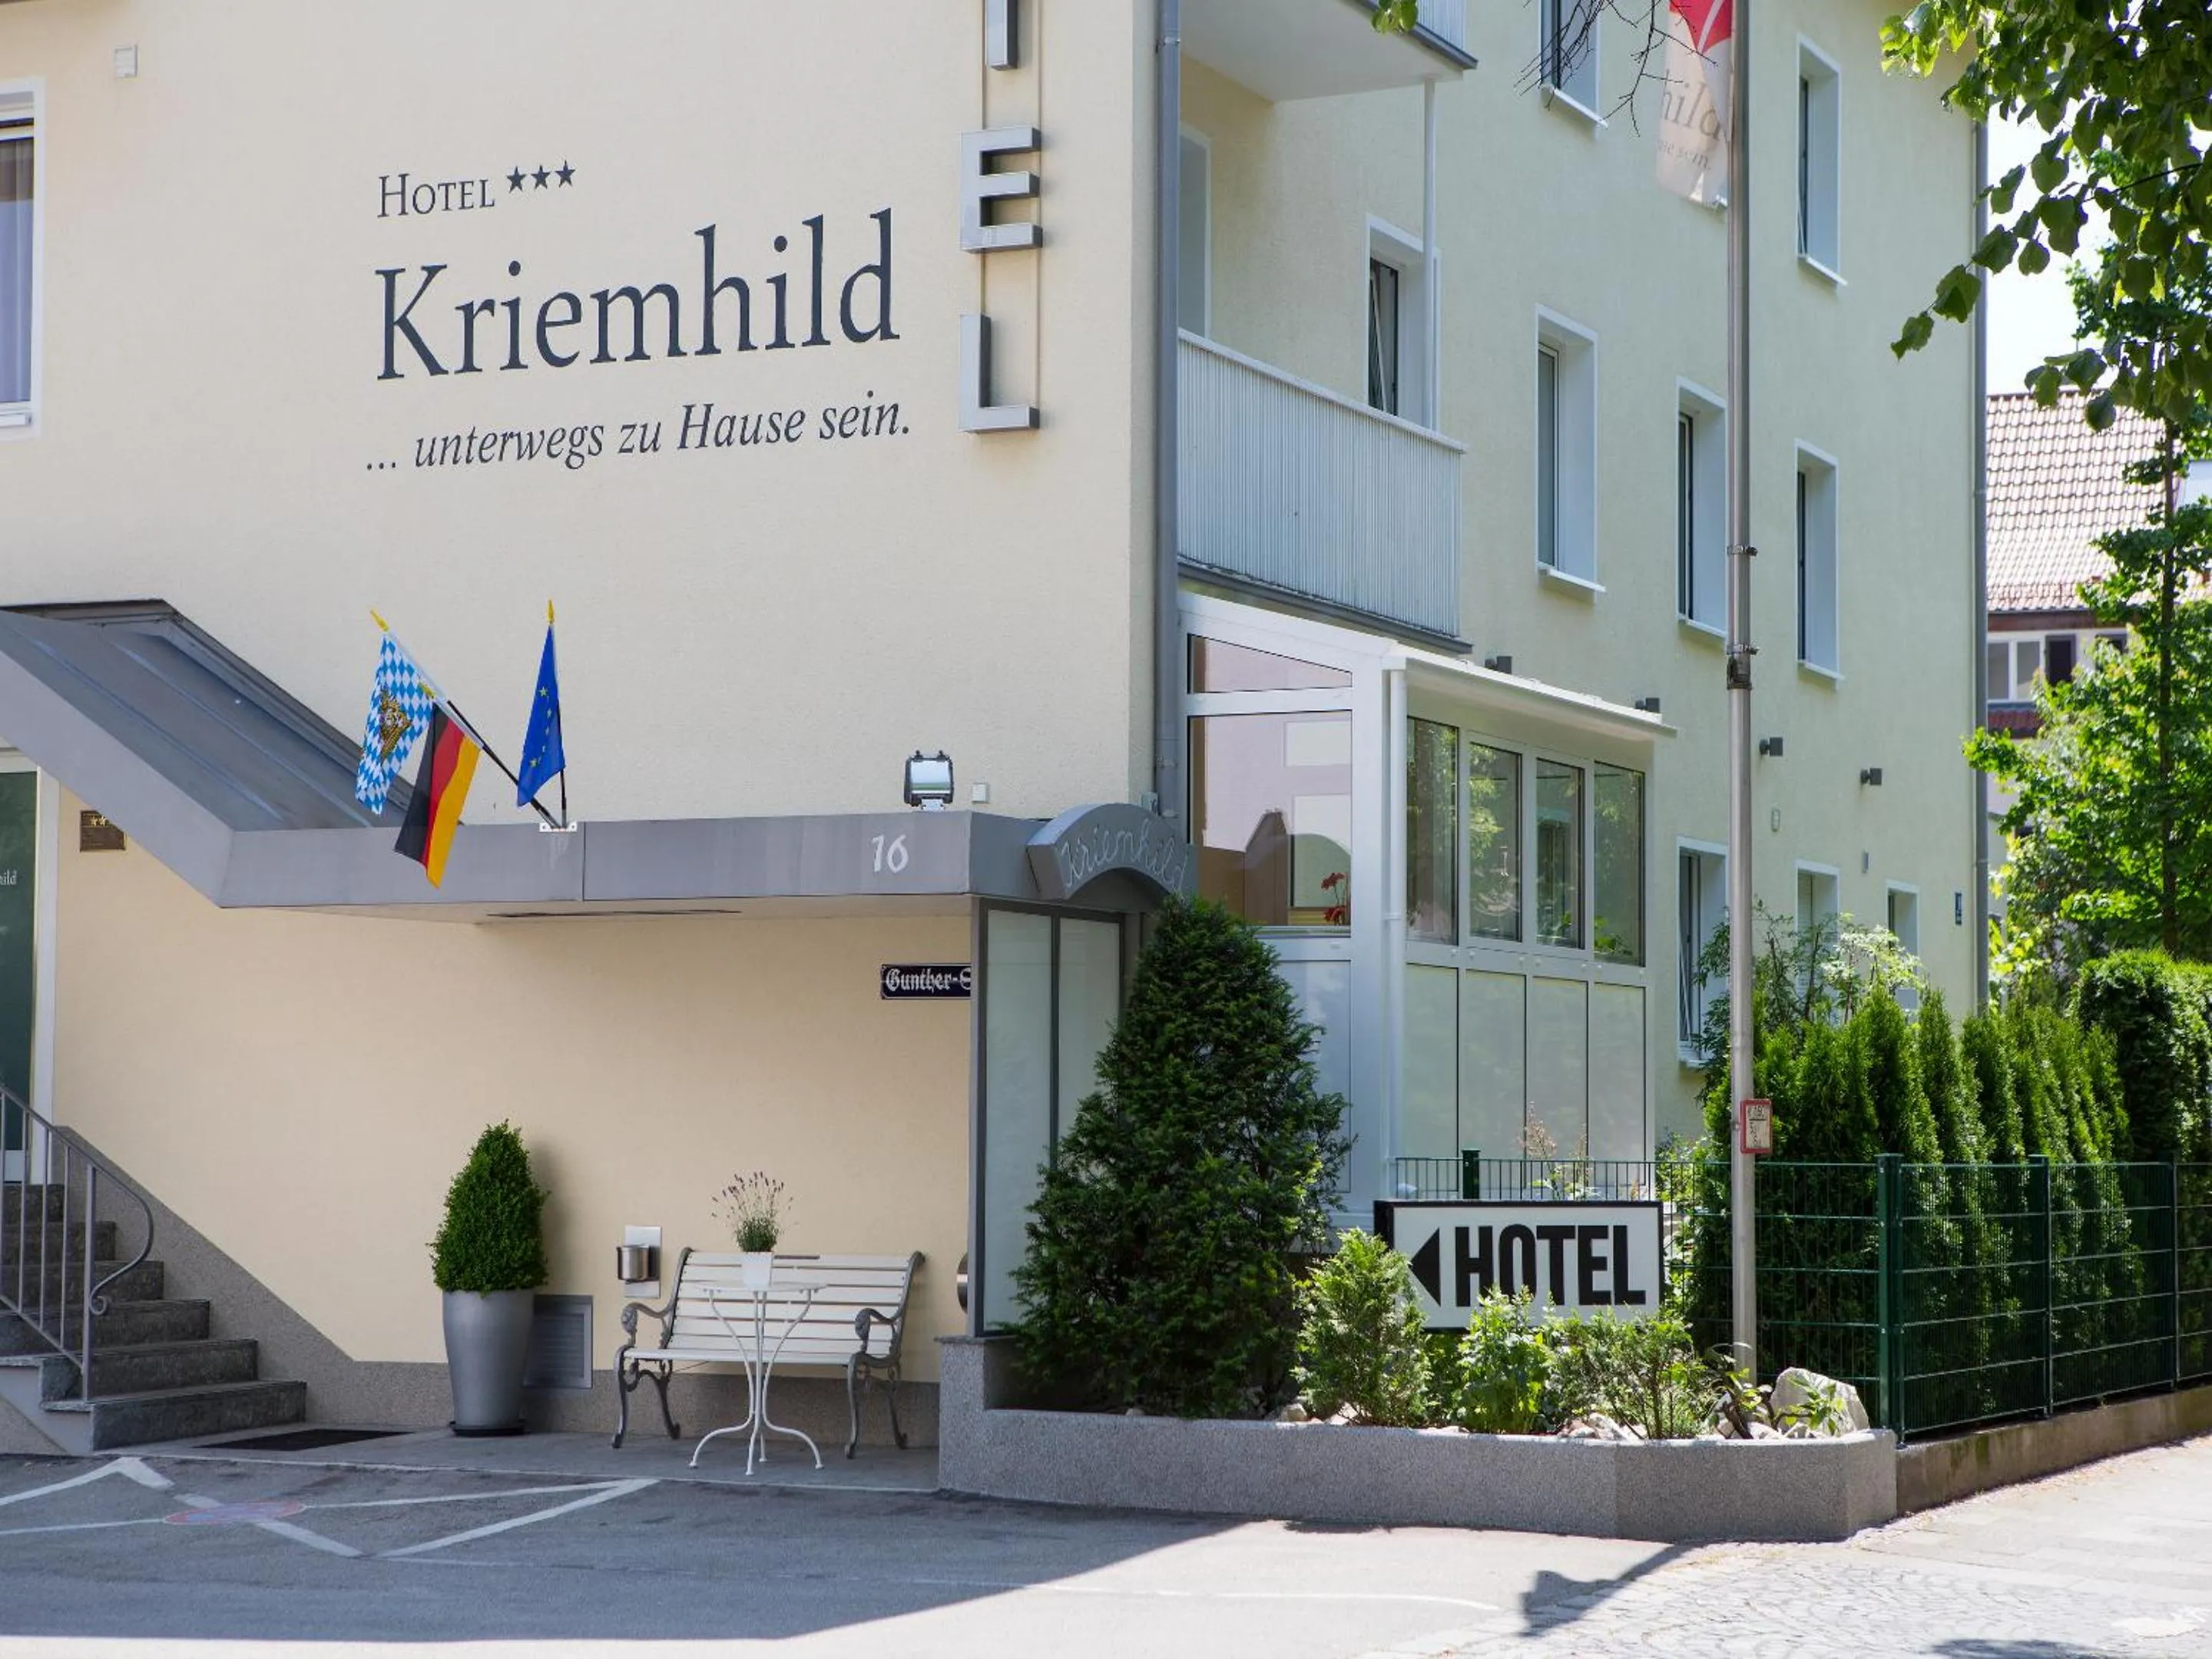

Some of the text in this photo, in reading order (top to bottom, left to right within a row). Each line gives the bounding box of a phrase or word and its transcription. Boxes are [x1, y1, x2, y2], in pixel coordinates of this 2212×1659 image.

[374, 207, 900, 381] Kriemhild
[415, 425, 604, 470] unterwegs
[618, 422, 661, 454] zu
[677, 402, 806, 450] Hause
[819, 389, 909, 440] sein.
[871, 833, 909, 873] 16
[1455, 1223, 1647, 1306] HOTEL
